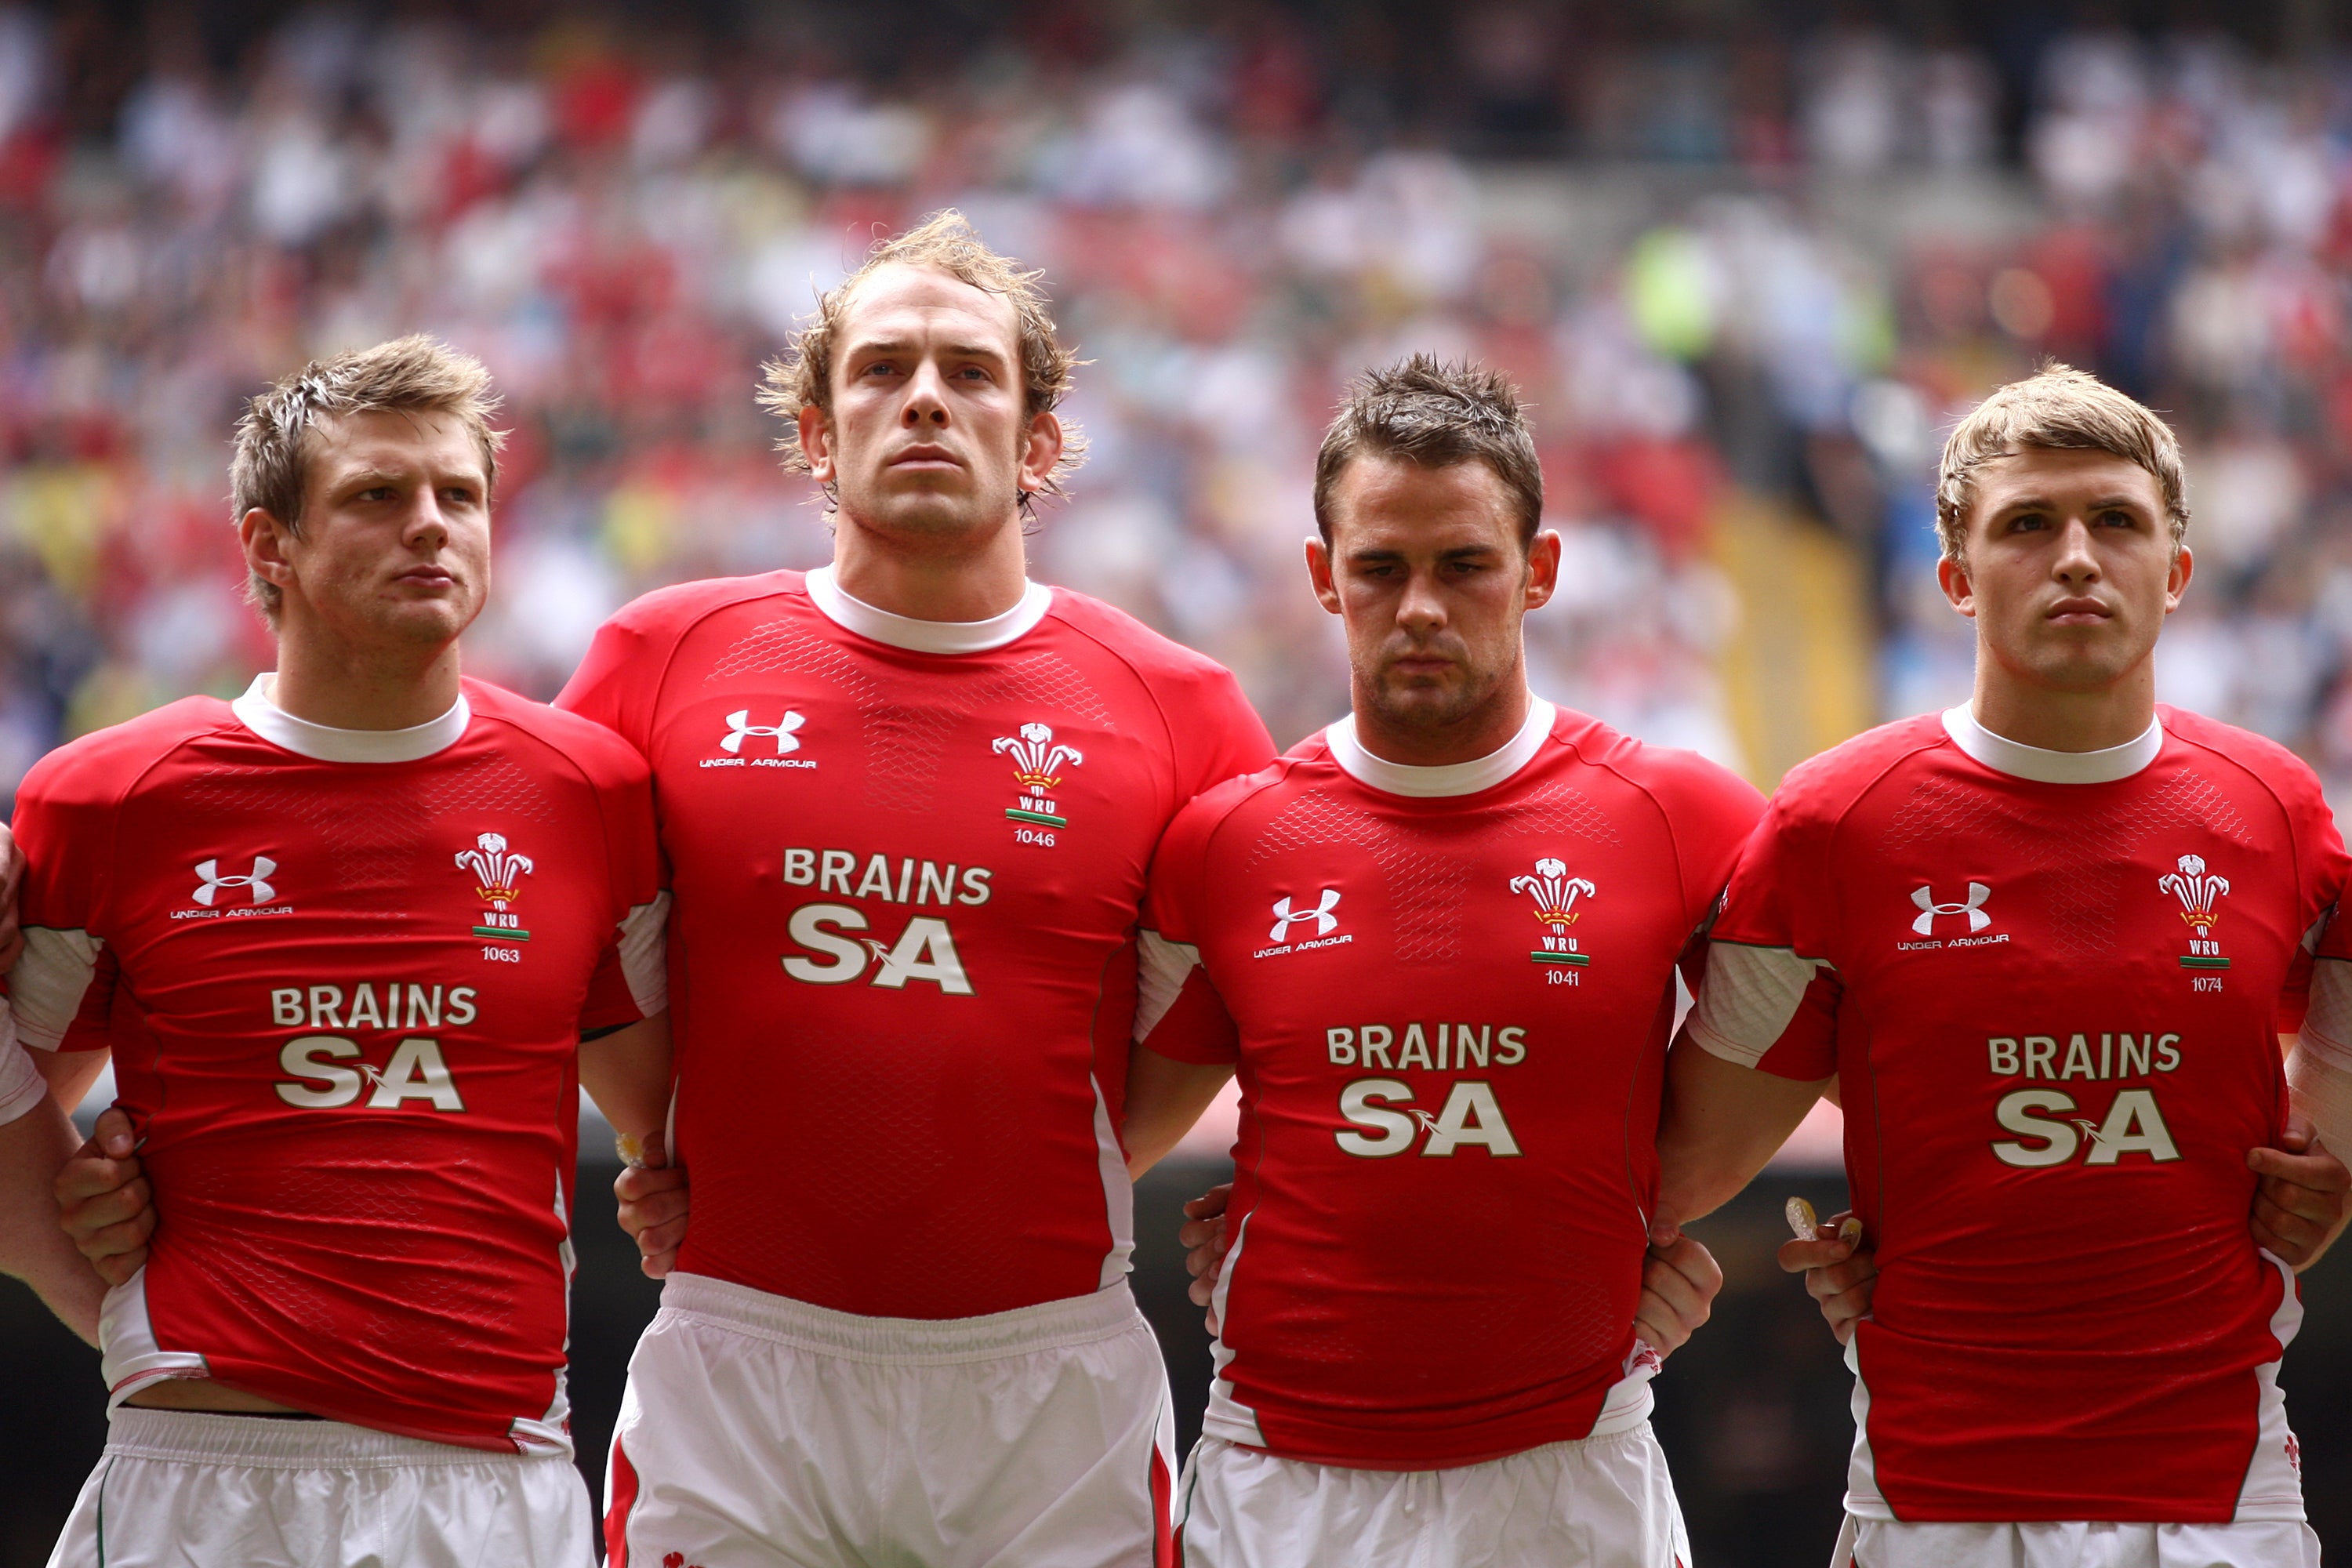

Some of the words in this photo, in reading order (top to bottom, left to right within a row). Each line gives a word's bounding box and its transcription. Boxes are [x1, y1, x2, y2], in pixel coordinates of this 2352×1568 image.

[699, 758, 746, 768] UNDER
[750, 758, 817, 769] ARMOUR
[1018, 796, 1056, 815] WRU
[1014, 827, 1055, 848] 1046
[782, 848, 993, 906] BRAINS
[170, 909, 220, 920] UNDER
[225, 906, 293, 917] ARMOUR
[484, 912, 518, 928] WRU
[780, 902, 977, 996] SA
[1254, 945, 1291, 959] UNDER
[1295, 934, 1352, 952] ARMOUR
[1542, 935, 1577, 953] WRU
[1897, 940, 1943, 951] UNDER
[1947, 933, 2009, 948] ARMOUR
[2189, 939, 2220, 956] WRU
[481, 946, 520, 963] 1063
[1545, 969, 1579, 986] 1041
[2191, 977, 2223, 993] 1074
[270, 982, 477, 1029] BRAINS
[1326, 1022, 1526, 1071] BRAINS
[1987, 1033, 2181, 1080] BRAINS
[276, 1036, 464, 1111] SA
[1334, 1079, 1520, 1157] SA
[1992, 1090, 2180, 1167] SA
